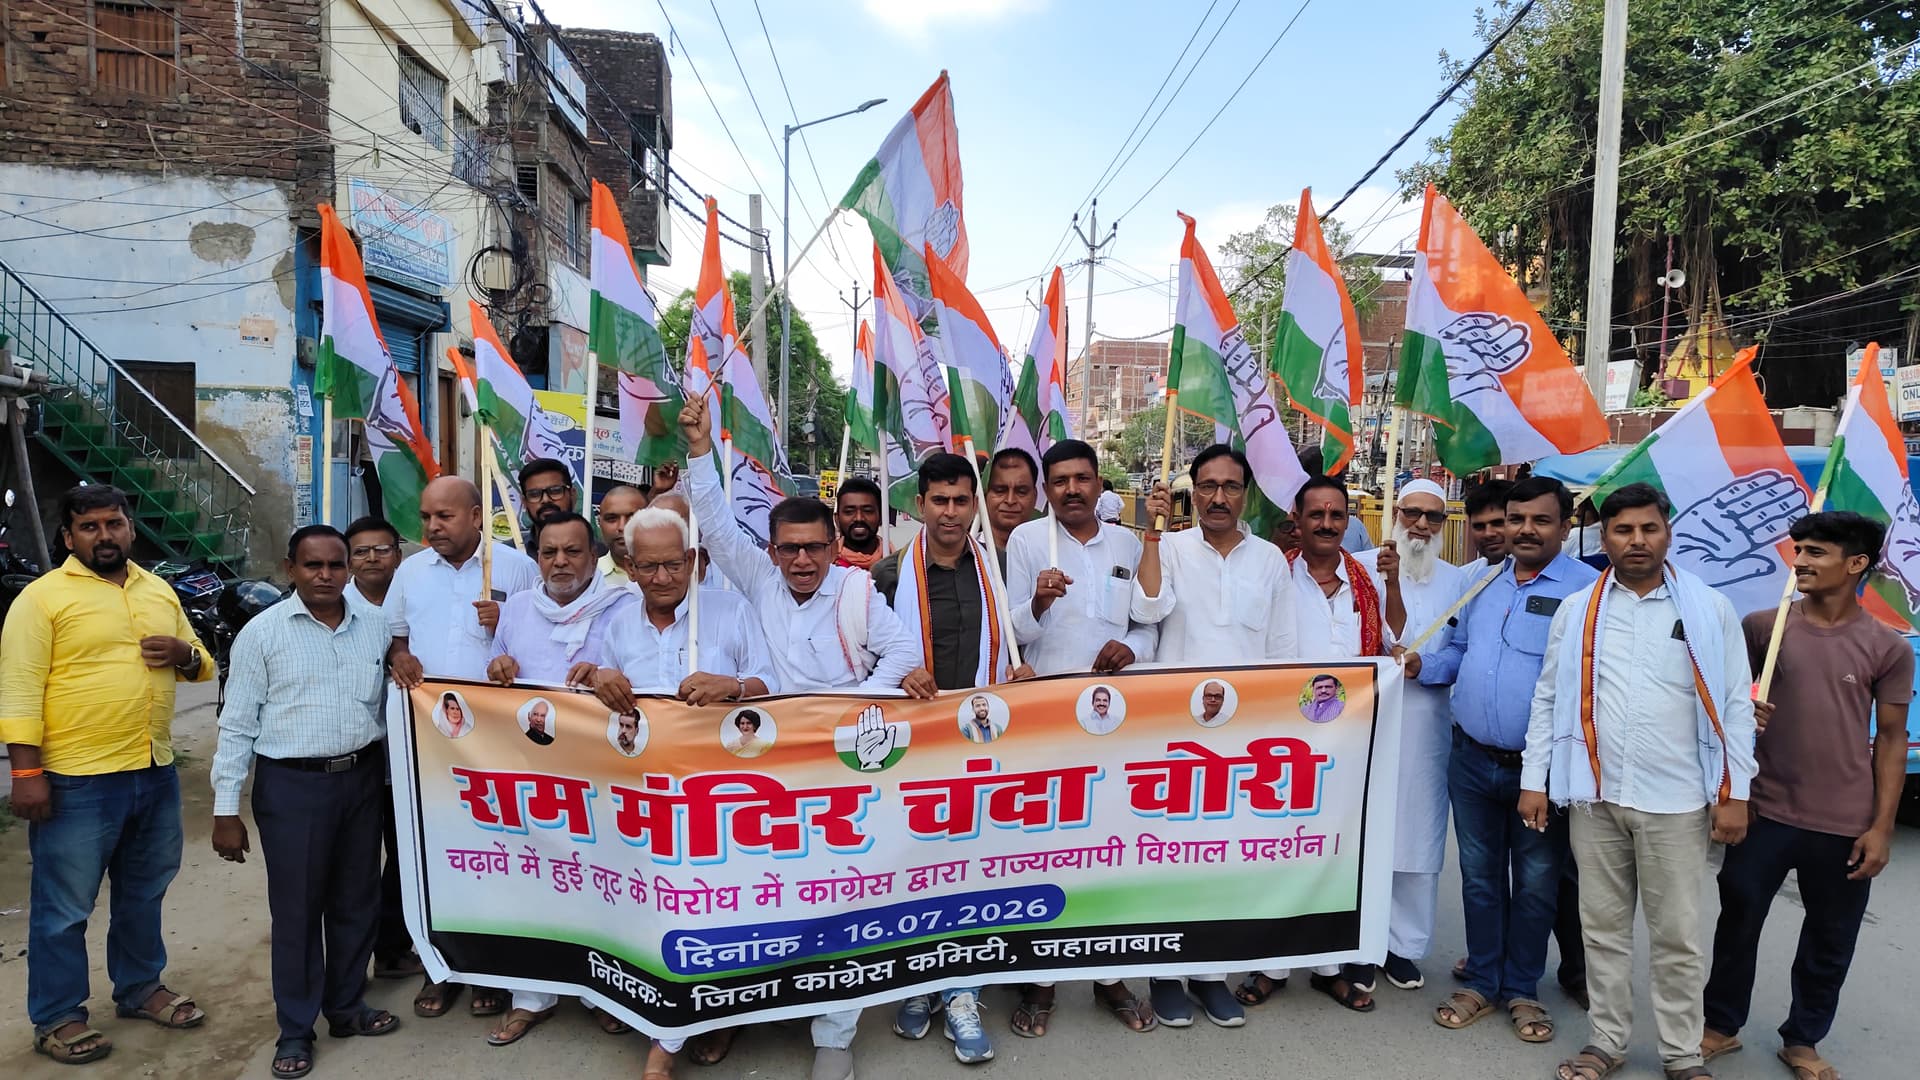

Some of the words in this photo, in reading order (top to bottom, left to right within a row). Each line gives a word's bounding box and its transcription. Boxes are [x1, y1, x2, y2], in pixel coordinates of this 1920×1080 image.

[453, 767, 592, 838] राम
[611, 773, 873, 860] मंदिर
[899, 758, 1099, 837] चंदा
[1124, 737, 1329, 816] चोरी
[446, 843, 509, 880] चढ़ावें
[519, 844, 540, 878] में
[548, 851, 583, 892] हुई
[592, 865, 621, 905] लूट
[628, 868, 648, 903] के
[654, 875, 741, 915] विरोध
[752, 872, 784, 907] में
[798, 866, 896, 905] कांग्रेस
[905, 858, 969, 893] द्वारा
[980, 835, 1127, 878] राज्यव्यापी
[1136, 832, 1229, 865] विशाल
[675, 932, 801, 968] दिनांक
[844, 898, 1048, 944] 16.07.2026
[691, 978, 780, 1013] जिला
[793, 959, 896, 994] कांग्रेस
[906, 937, 1018, 974] कमिटी,
[1031, 933, 1183, 958] जहानाबाद
